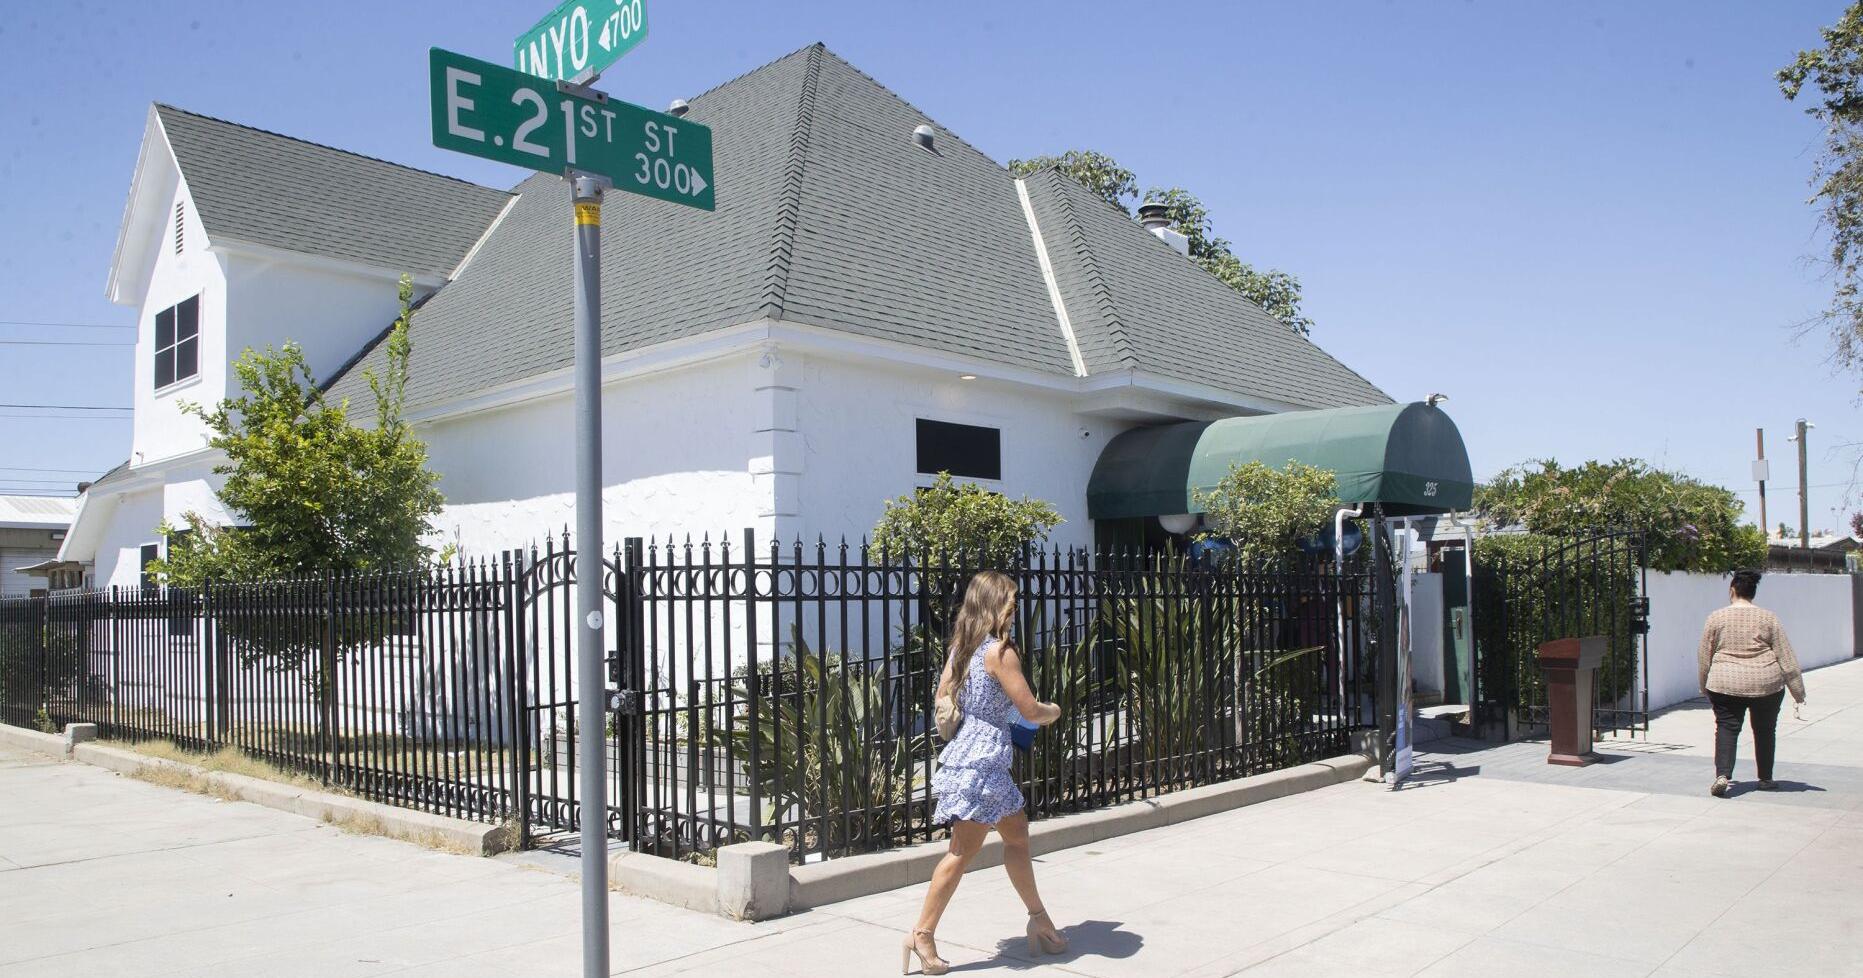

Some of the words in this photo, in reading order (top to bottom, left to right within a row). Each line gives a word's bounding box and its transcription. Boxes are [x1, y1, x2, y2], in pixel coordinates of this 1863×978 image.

[610, 0, 641, 47] 700
[645, 121, 677, 157] ST
[635, 153, 691, 195] 300
[1424, 481, 1438, 497] 325
